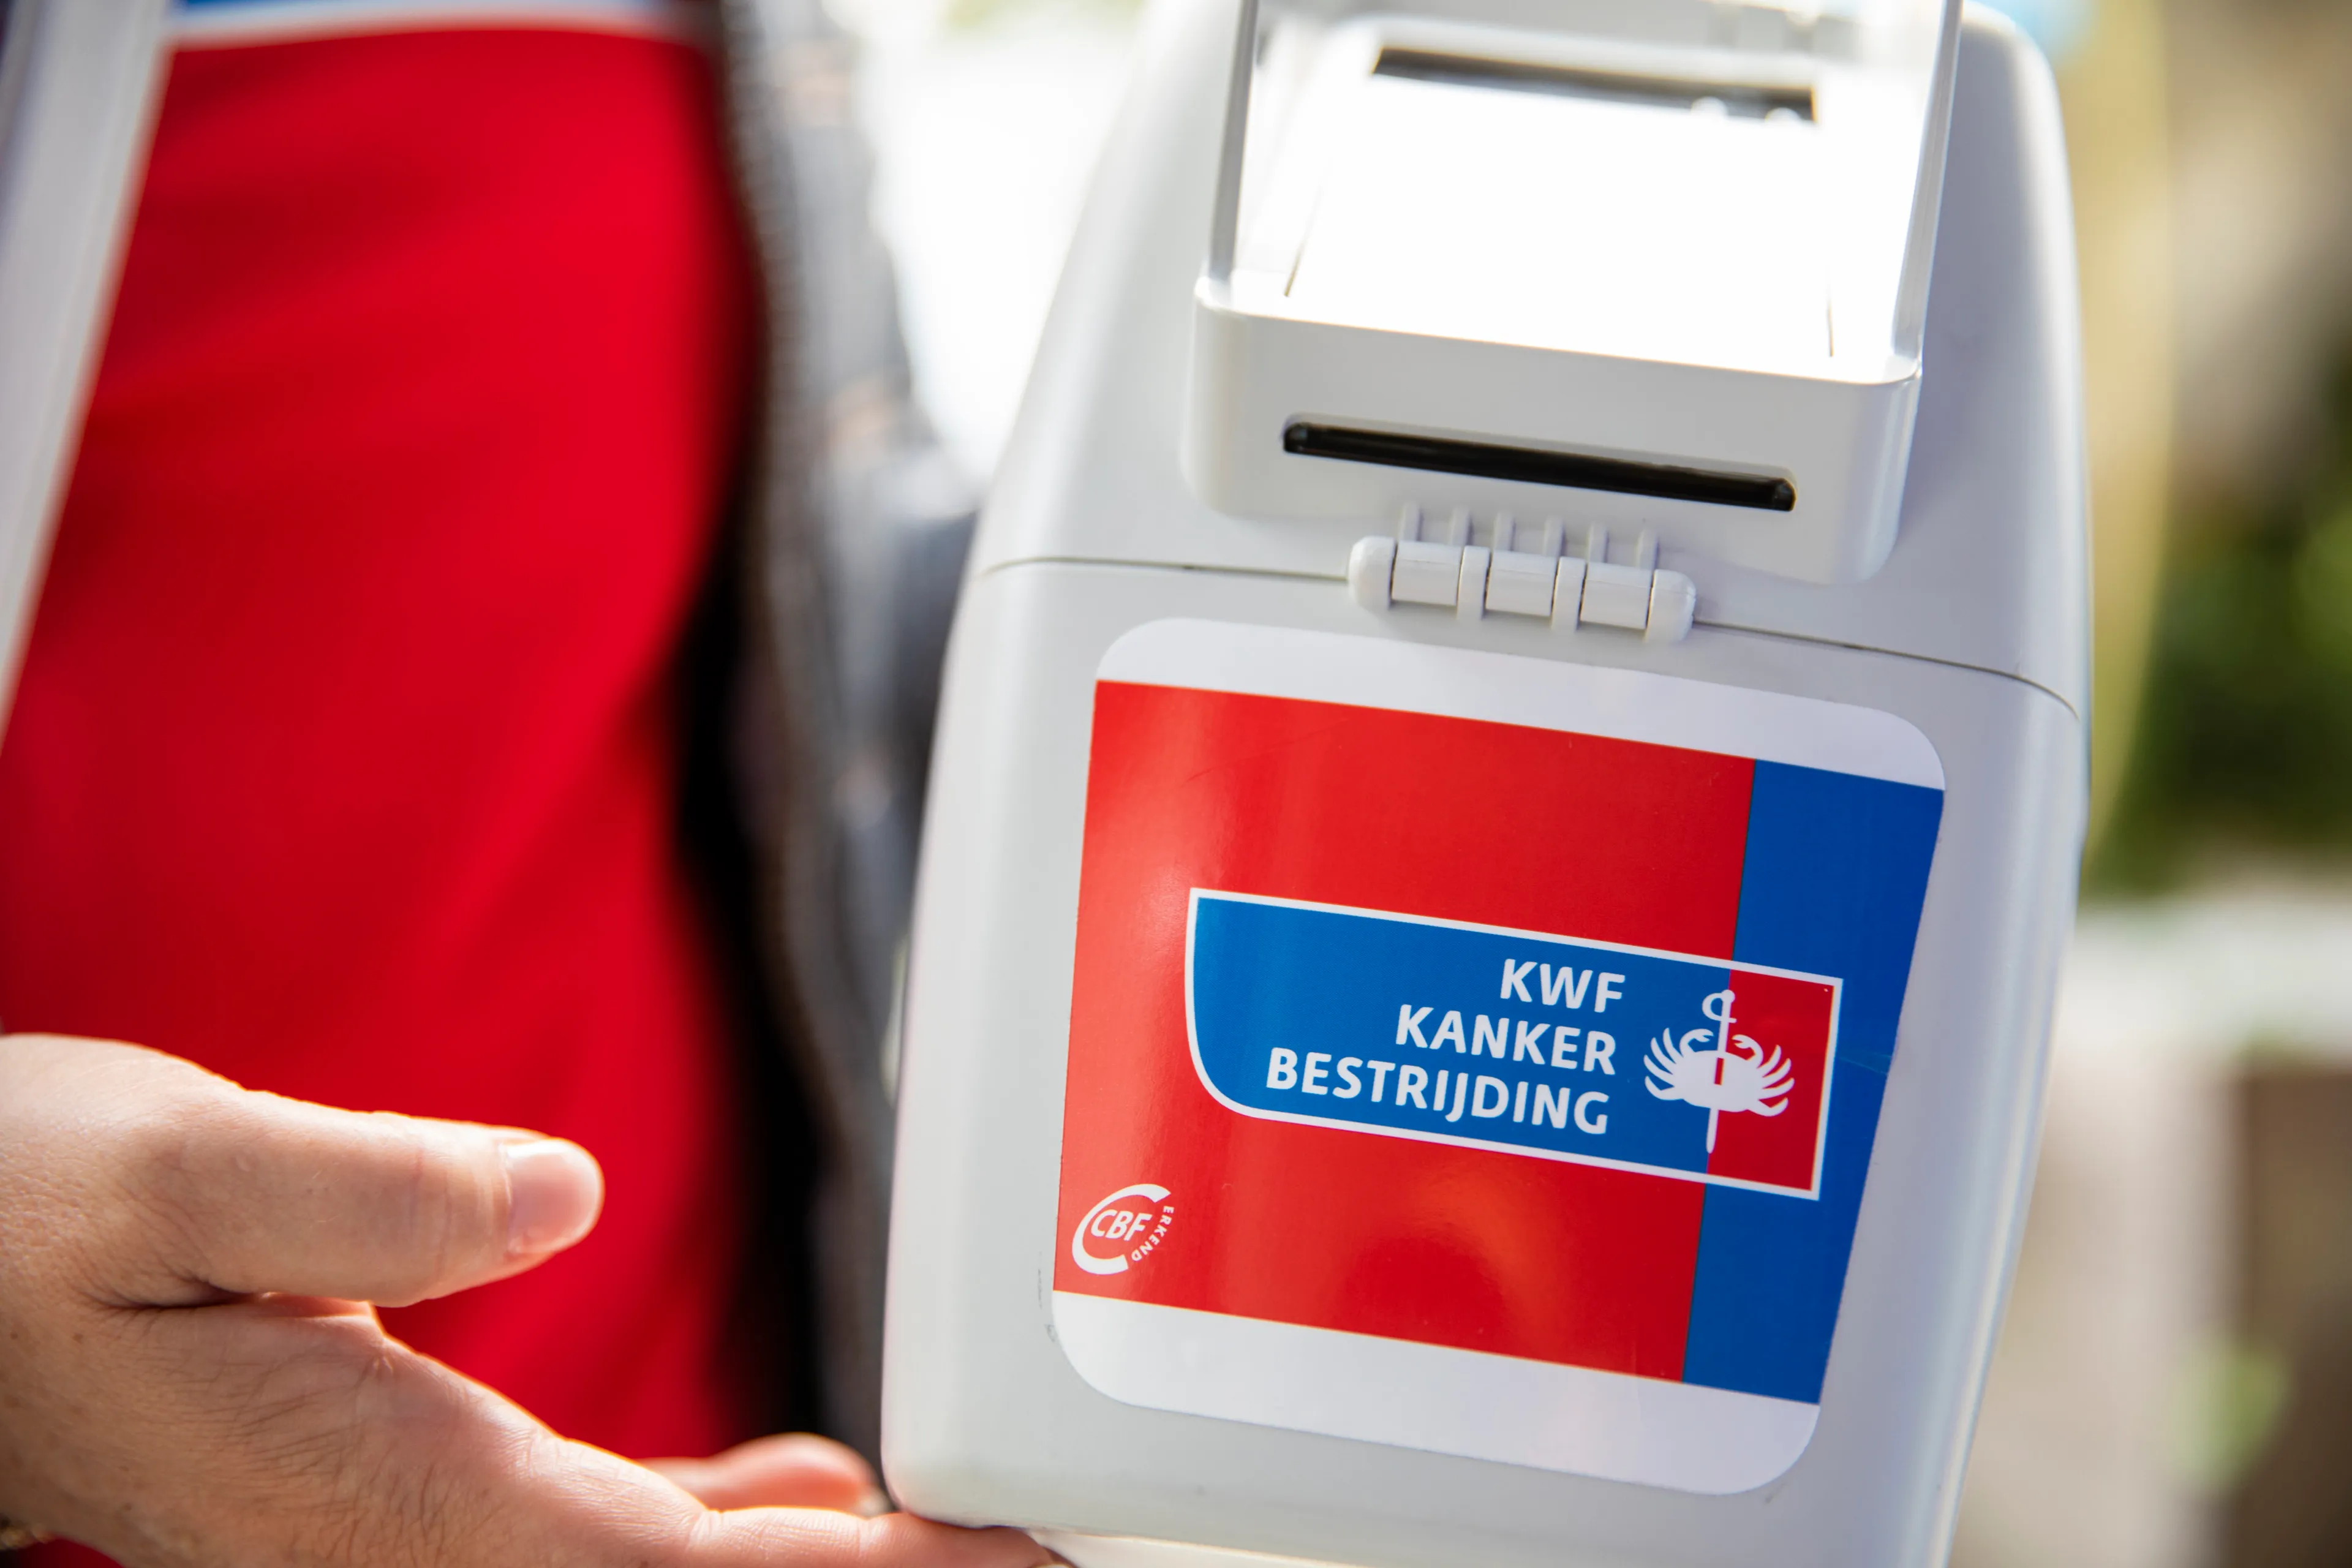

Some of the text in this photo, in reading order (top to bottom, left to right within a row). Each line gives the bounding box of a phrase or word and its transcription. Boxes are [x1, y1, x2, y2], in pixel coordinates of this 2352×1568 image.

[1501, 959, 1625, 1013] KWF
[1396, 1004, 1616, 1075] KANKER
[1266, 1047, 1609, 1134] BESTRIJDING
[1090, 1209, 1153, 1241] CBF
[1131, 1205, 1175, 1262] ERKEND
